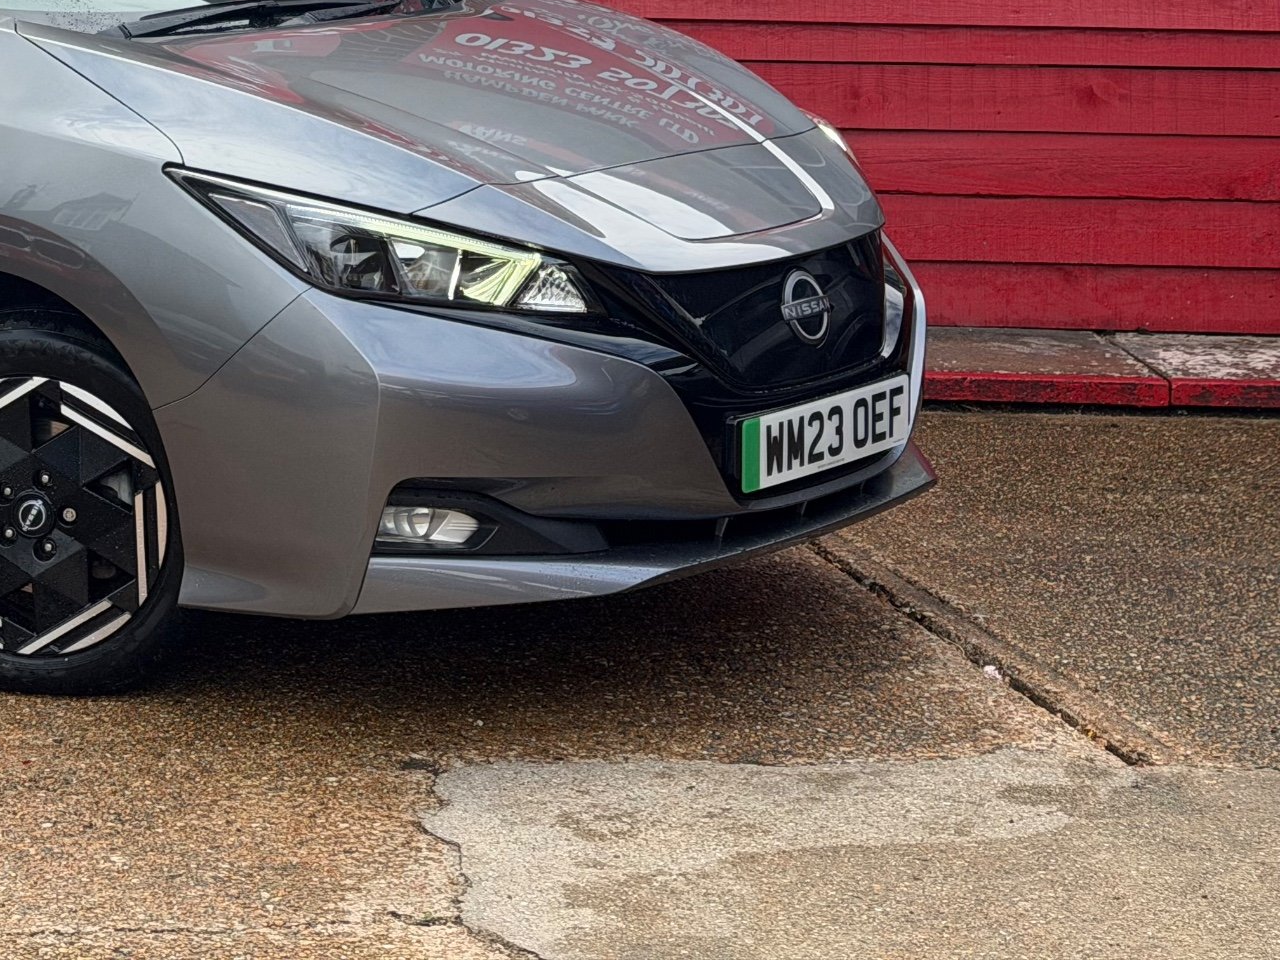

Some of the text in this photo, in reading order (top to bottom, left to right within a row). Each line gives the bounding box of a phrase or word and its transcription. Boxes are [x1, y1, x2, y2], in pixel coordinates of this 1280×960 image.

[784, 296, 830, 319] NISSAN
[766, 385, 904, 477] WM23 OEF
